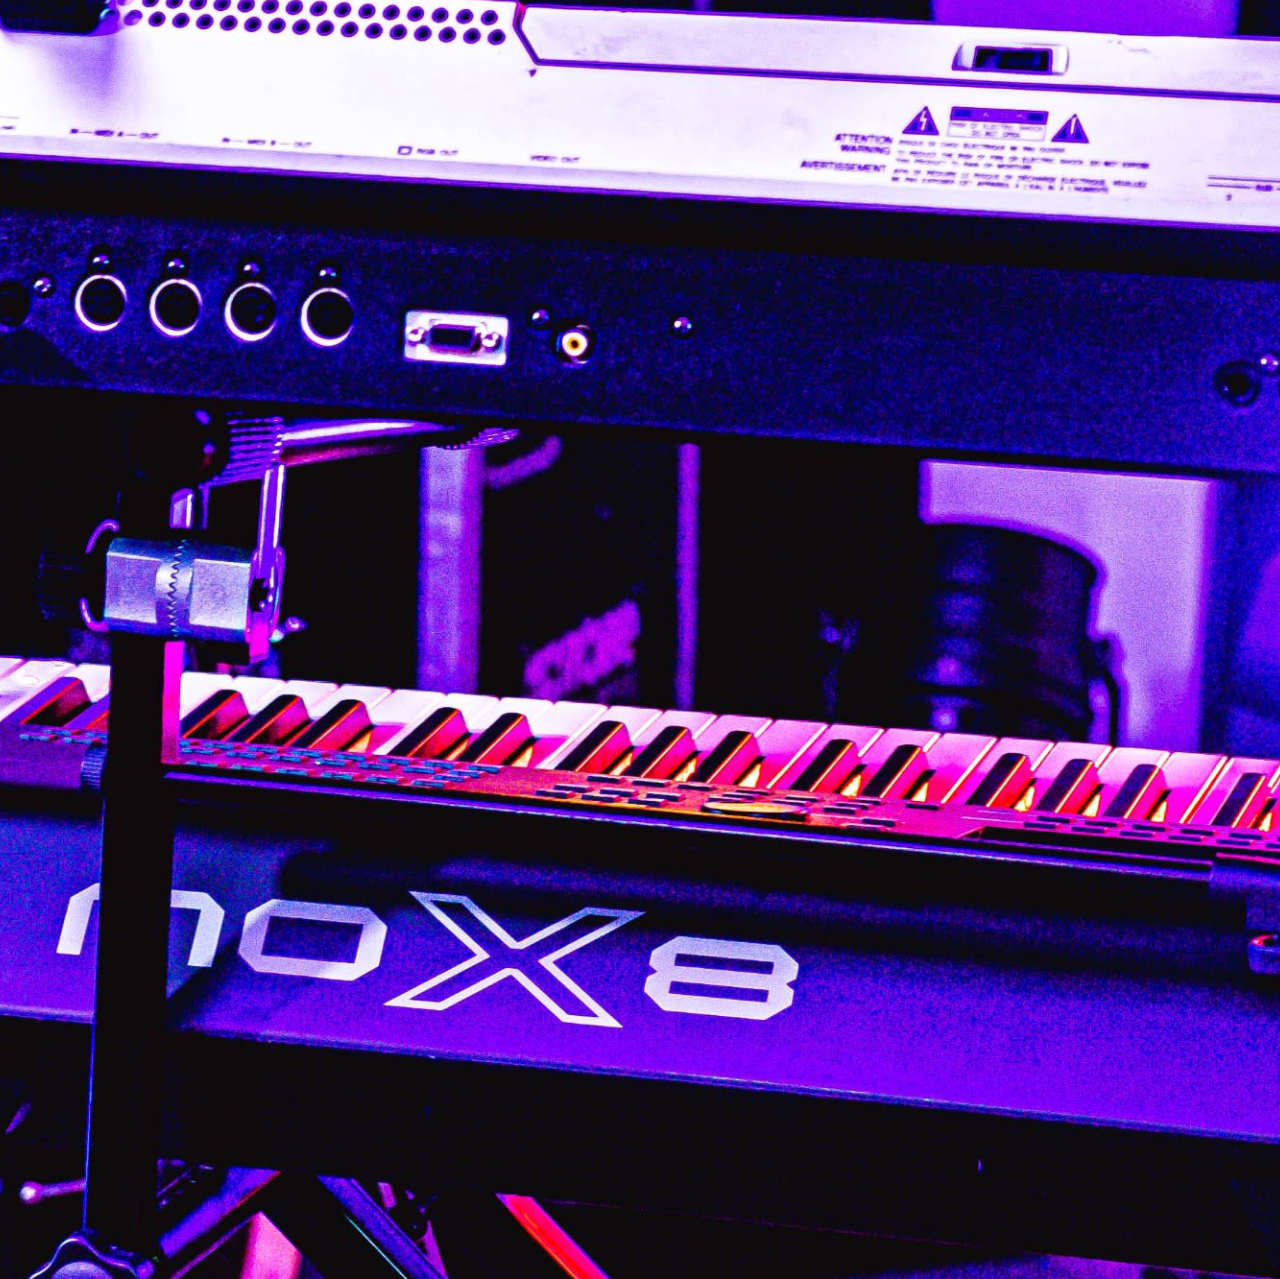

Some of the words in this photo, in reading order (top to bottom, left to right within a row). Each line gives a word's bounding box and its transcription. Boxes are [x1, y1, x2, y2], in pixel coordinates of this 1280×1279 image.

[835, 133, 893, 144] ATTENTION
[840, 144, 890, 155] WARNING
[800, 160, 887, 172] AVERTISSEMENT
